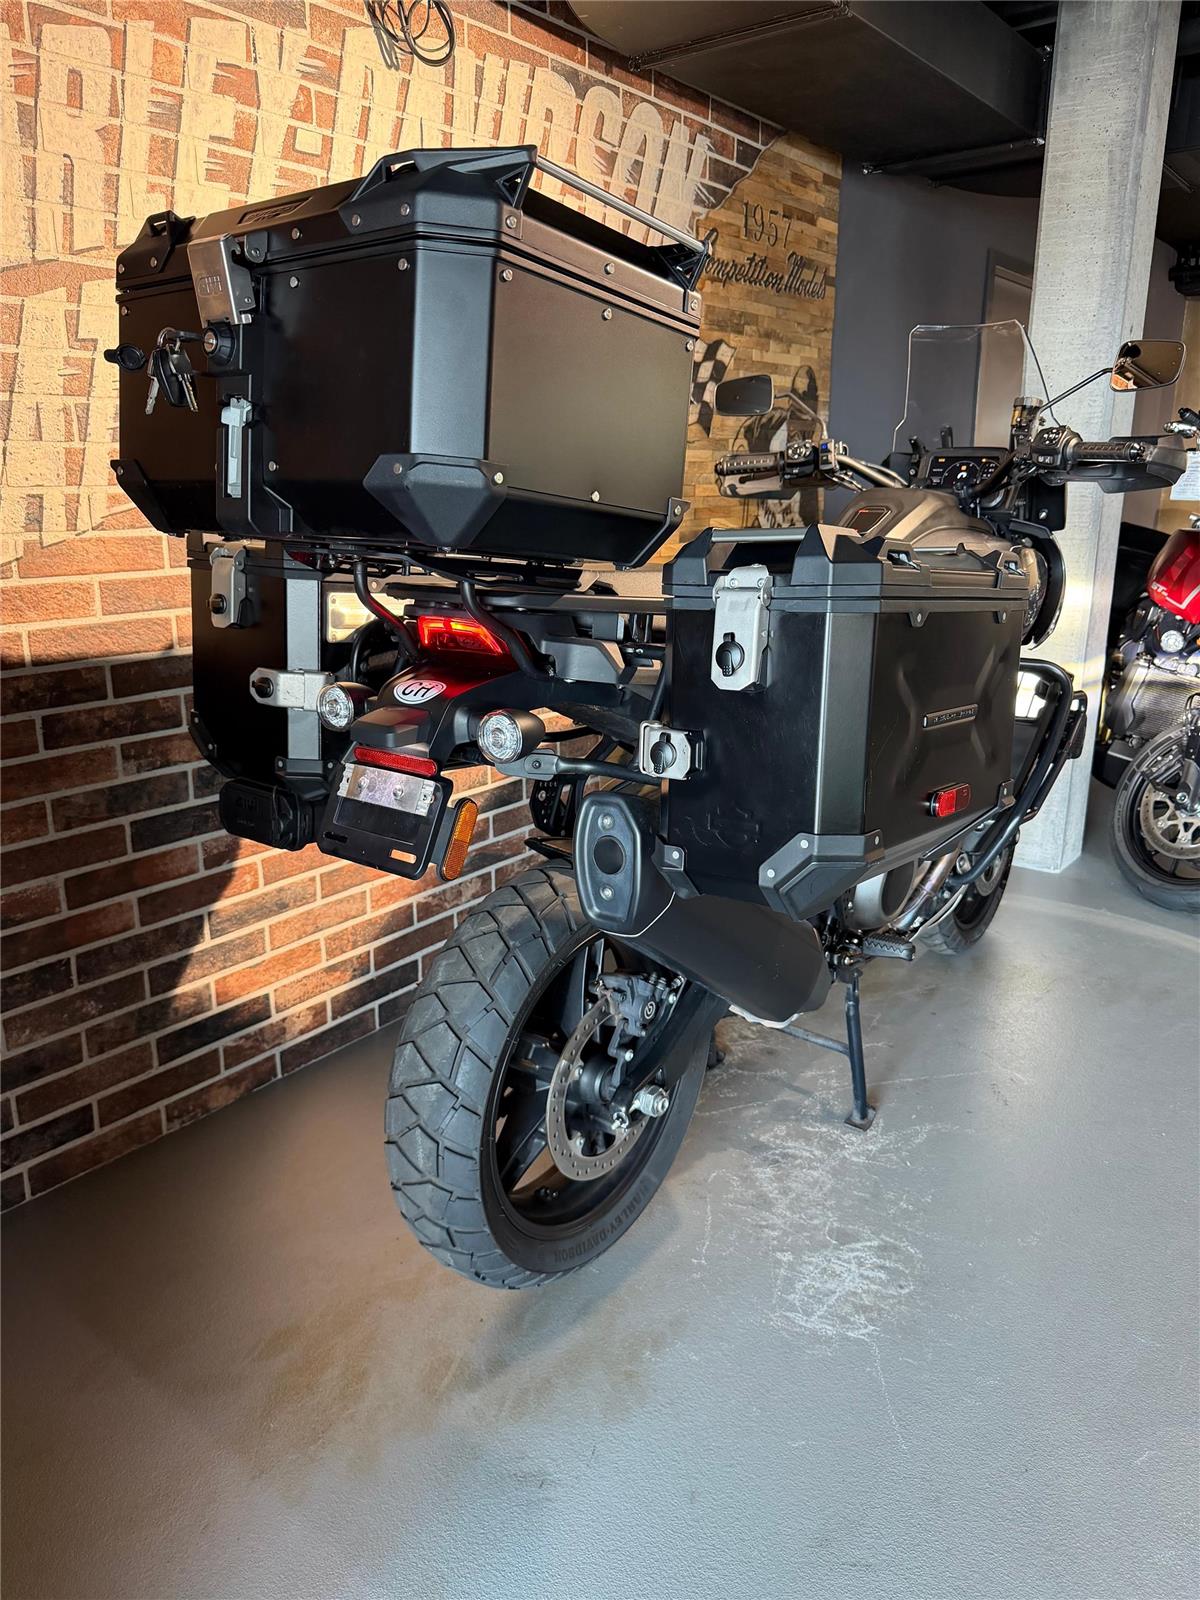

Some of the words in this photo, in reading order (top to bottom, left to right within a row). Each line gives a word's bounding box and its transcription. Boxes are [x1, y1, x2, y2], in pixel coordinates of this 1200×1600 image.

[742, 201, 792, 249] 1957
[782, 251, 828, 300] Models
[401, 681, 438, 698] CH
